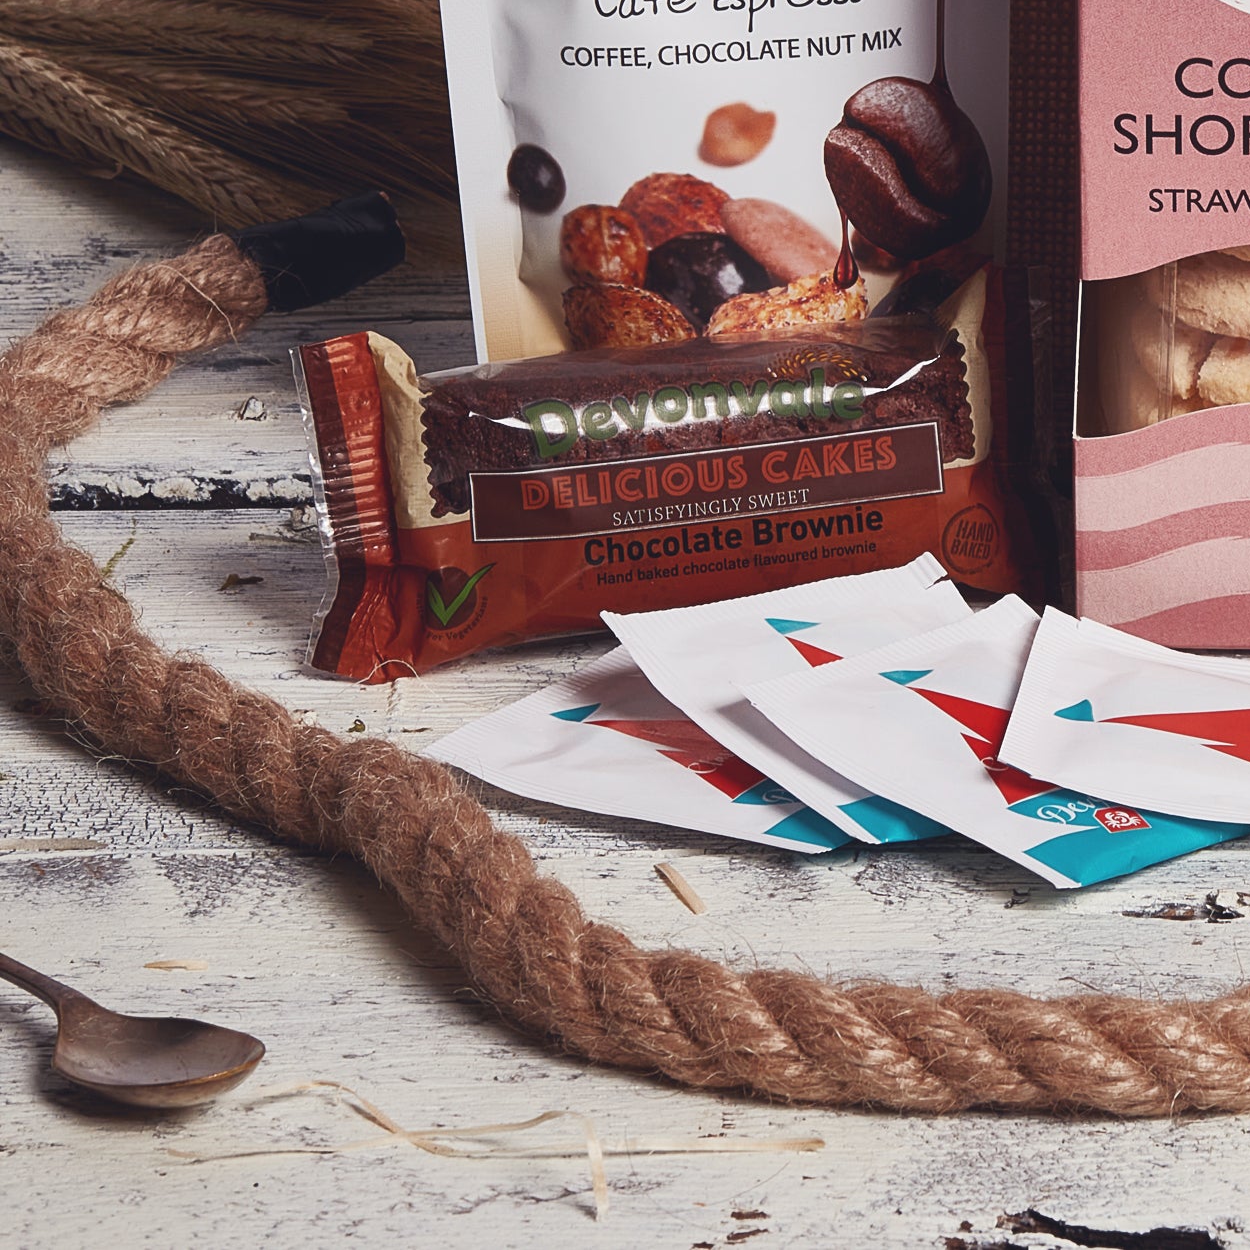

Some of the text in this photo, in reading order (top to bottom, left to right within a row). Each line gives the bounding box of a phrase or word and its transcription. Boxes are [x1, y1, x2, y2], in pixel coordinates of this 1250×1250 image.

[561, 27, 904, 69] COFFEE, CHOCOLATE NUT MIX
[521, 366, 868, 459] Devonvale
[520, 435, 898, 511] DELICIOUS CAKES
[612, 488, 810, 527] SATISFYINGLY SWEET
[584, 506, 884, 568] Chocolate Brownie
[950, 538, 992, 559] BAKED
[956, 519, 995, 543] HAND
[596, 538, 877, 587] Hand baked chocolate flavoured brownie
